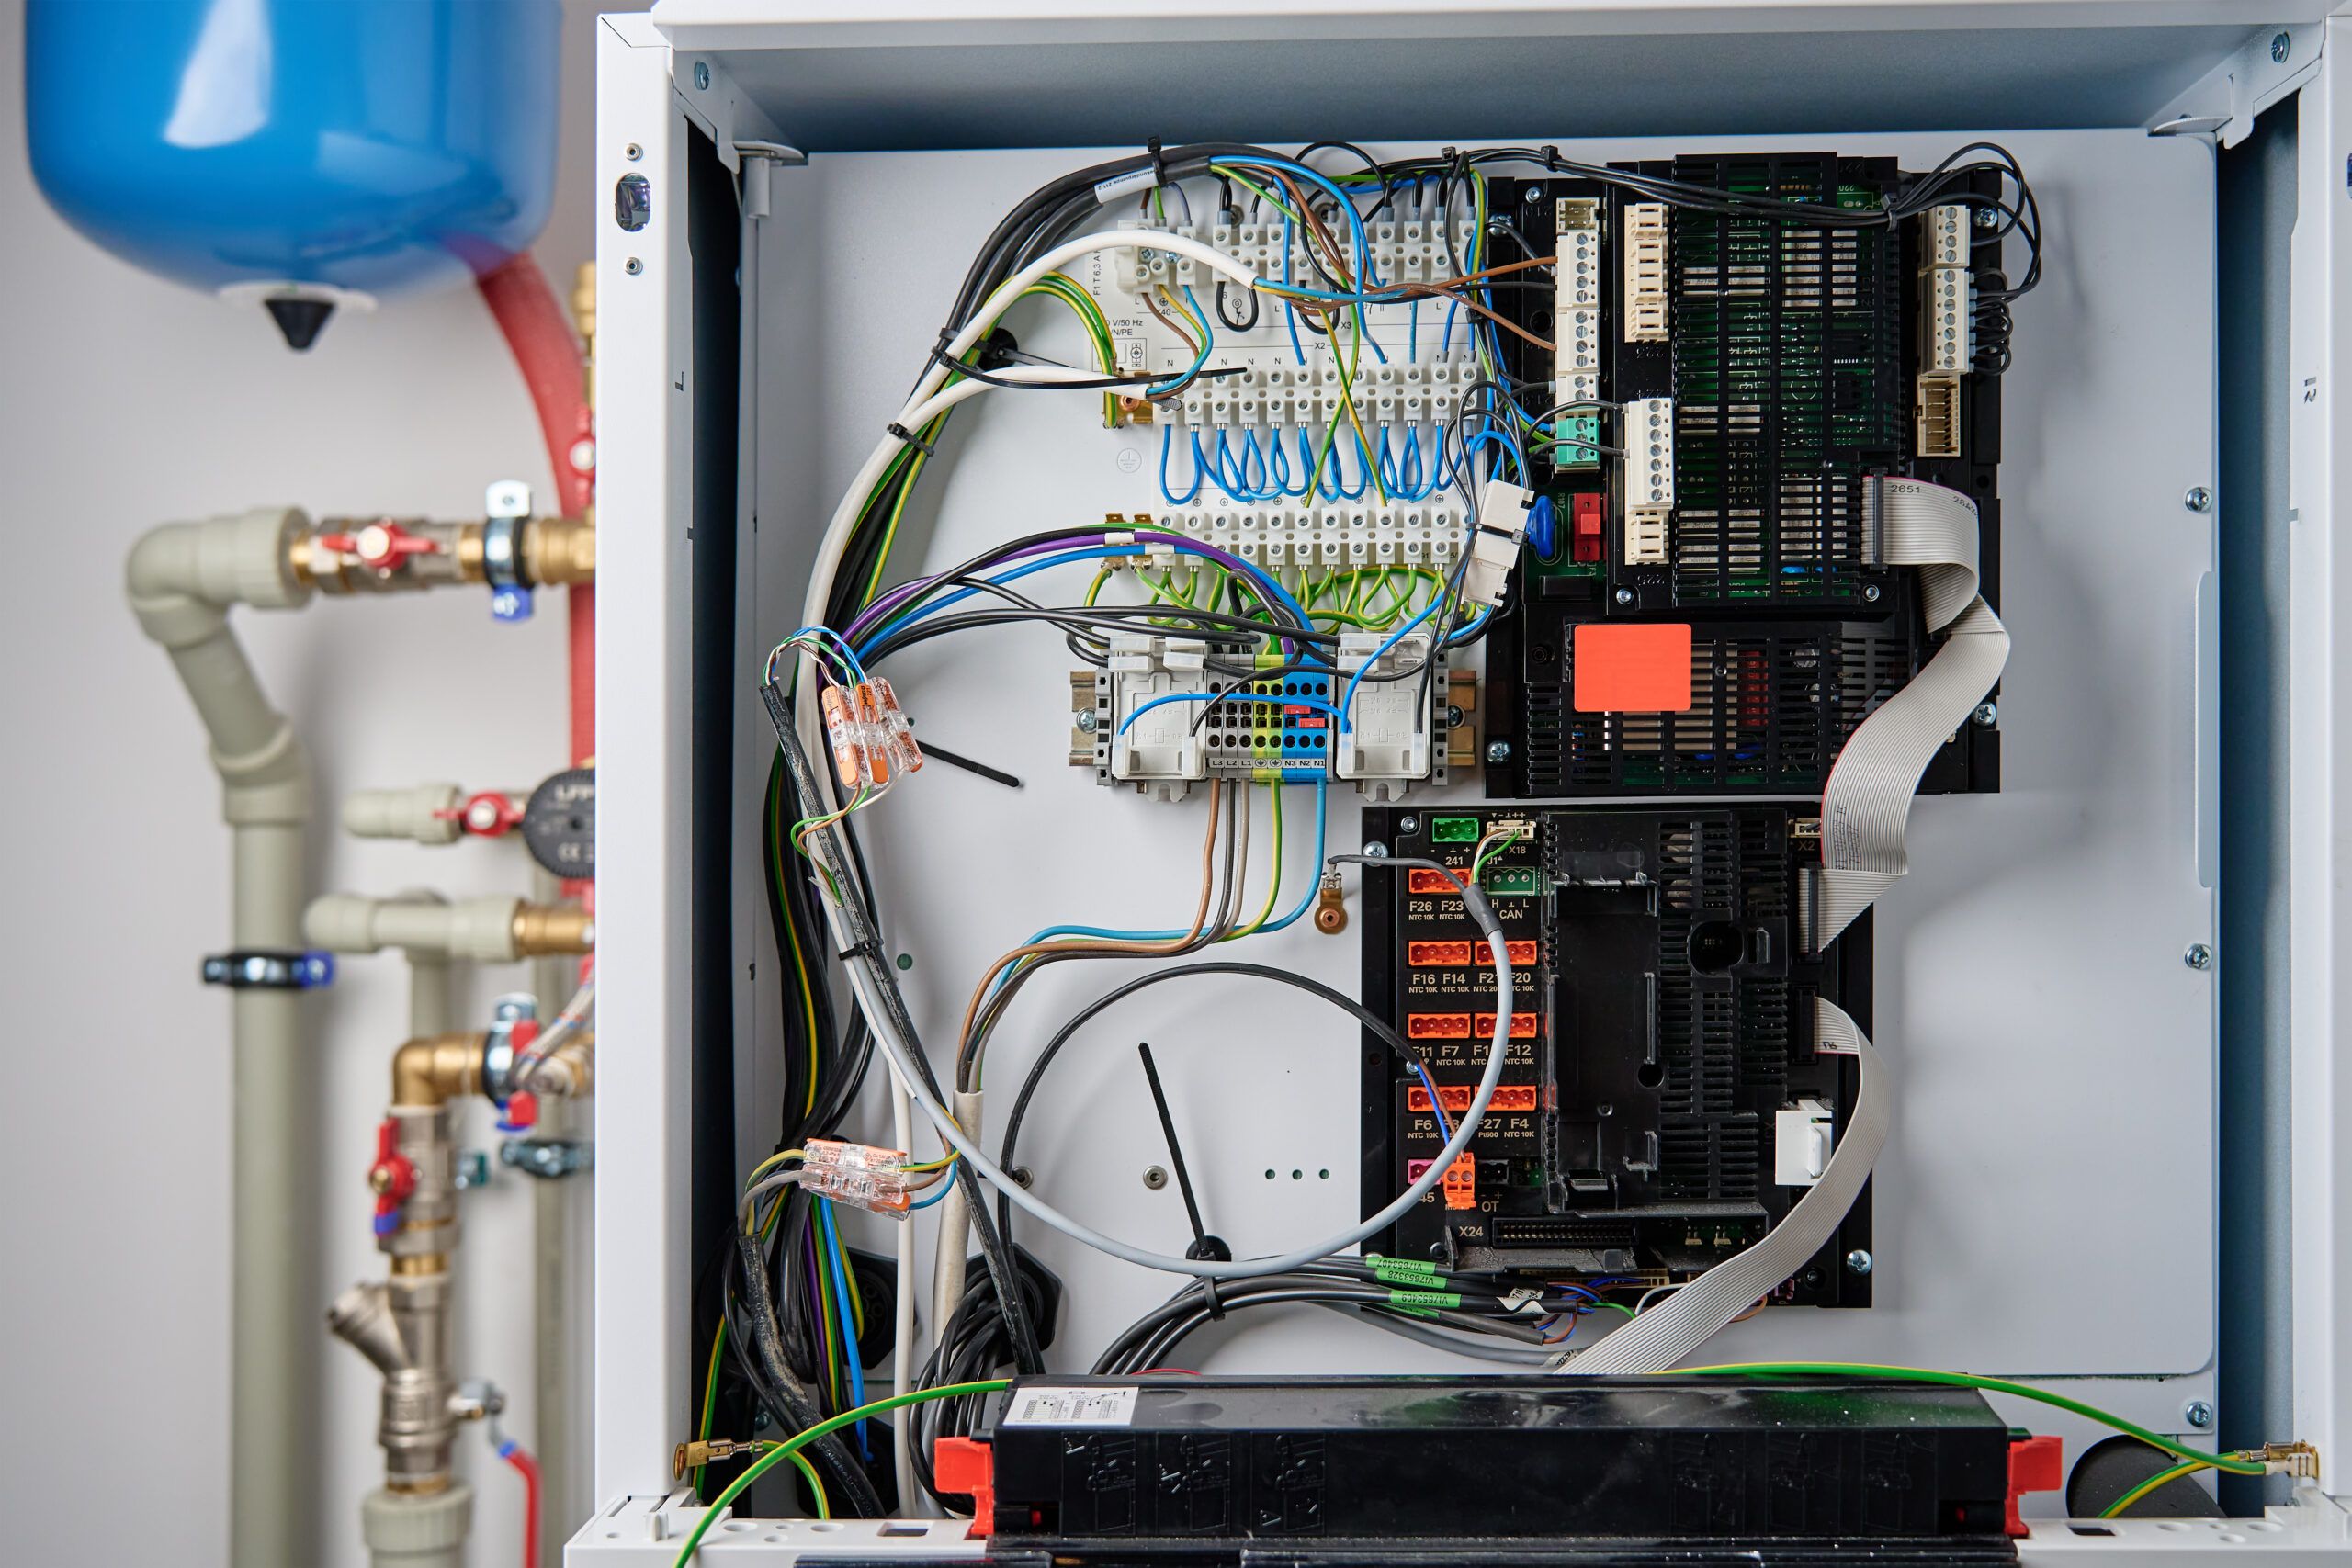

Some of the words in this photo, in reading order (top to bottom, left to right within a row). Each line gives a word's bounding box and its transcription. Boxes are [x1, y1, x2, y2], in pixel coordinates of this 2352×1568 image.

[1891, 484, 1920, 493] 2651
[1509, 846, 1526, 854] X18
[1445, 856, 1463, 865] 241
[1410, 901, 1432, 911] F26
[1441, 901, 1464, 911] F23
[1492, 899, 1499, 908] H
[1523, 899, 1529, 907] L
[1499, 910, 1523, 919] CAN
[1413, 974, 1436, 984] F16
[1443, 974, 1465, 984] F14
[1442, 1046, 1459, 1056] F7
[1473, 1045, 1489, 1056] F1
[1506, 1045, 1531, 1055] F12
[1415, 1120, 1432, 1130] F6
[1511, 1118, 1529, 1129] F4
[1481, 1201, 1499, 1212] OT
[1459, 1226, 1483, 1237] X24
